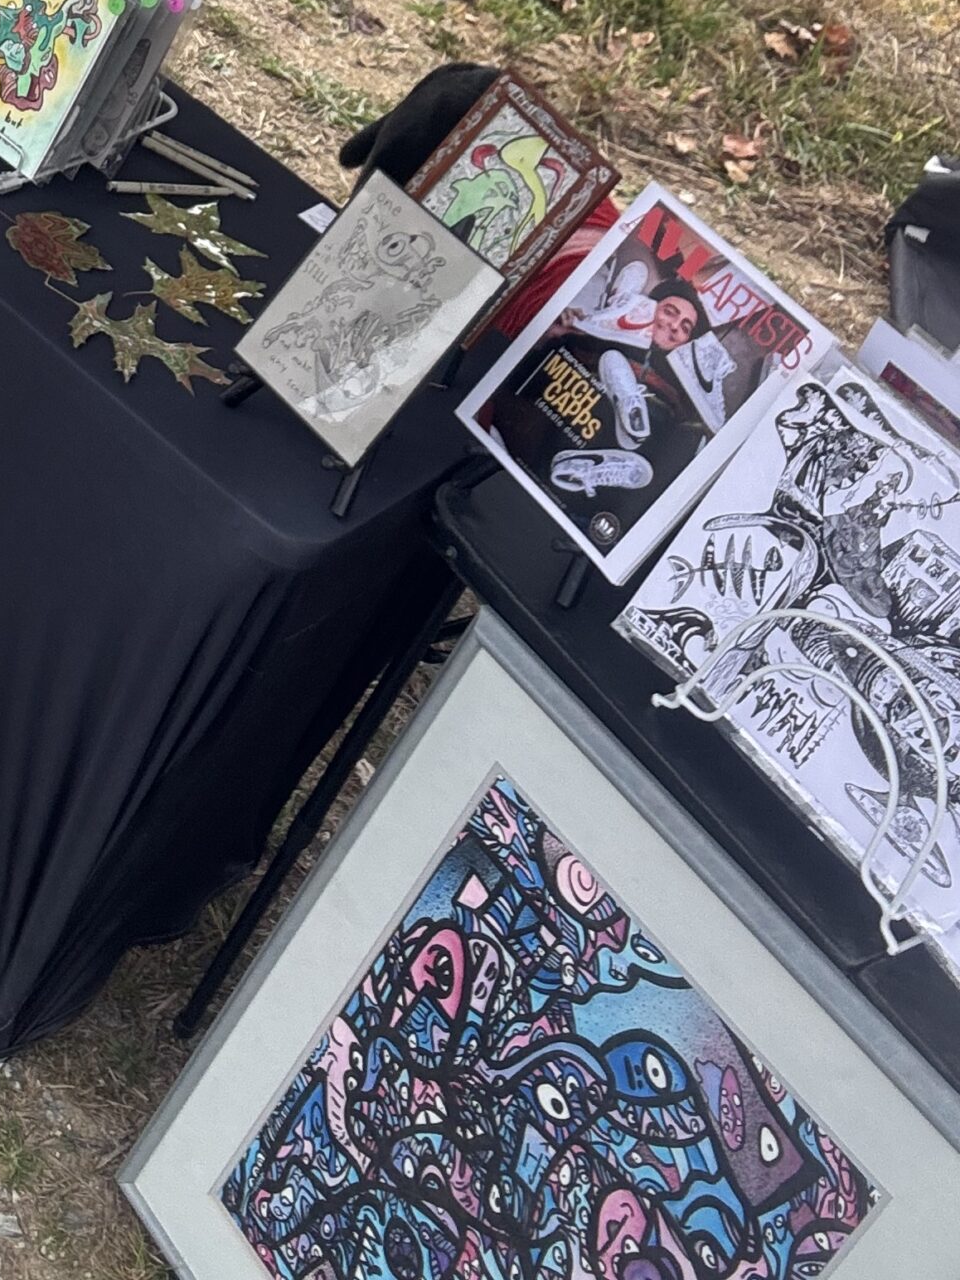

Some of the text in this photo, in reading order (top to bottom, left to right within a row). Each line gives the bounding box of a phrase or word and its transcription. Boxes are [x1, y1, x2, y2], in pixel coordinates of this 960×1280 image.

[700, 272, 813, 370] ARTISTS
[543, 354, 601, 409] MITCH
[543, 378, 601, 439] CAPPS
